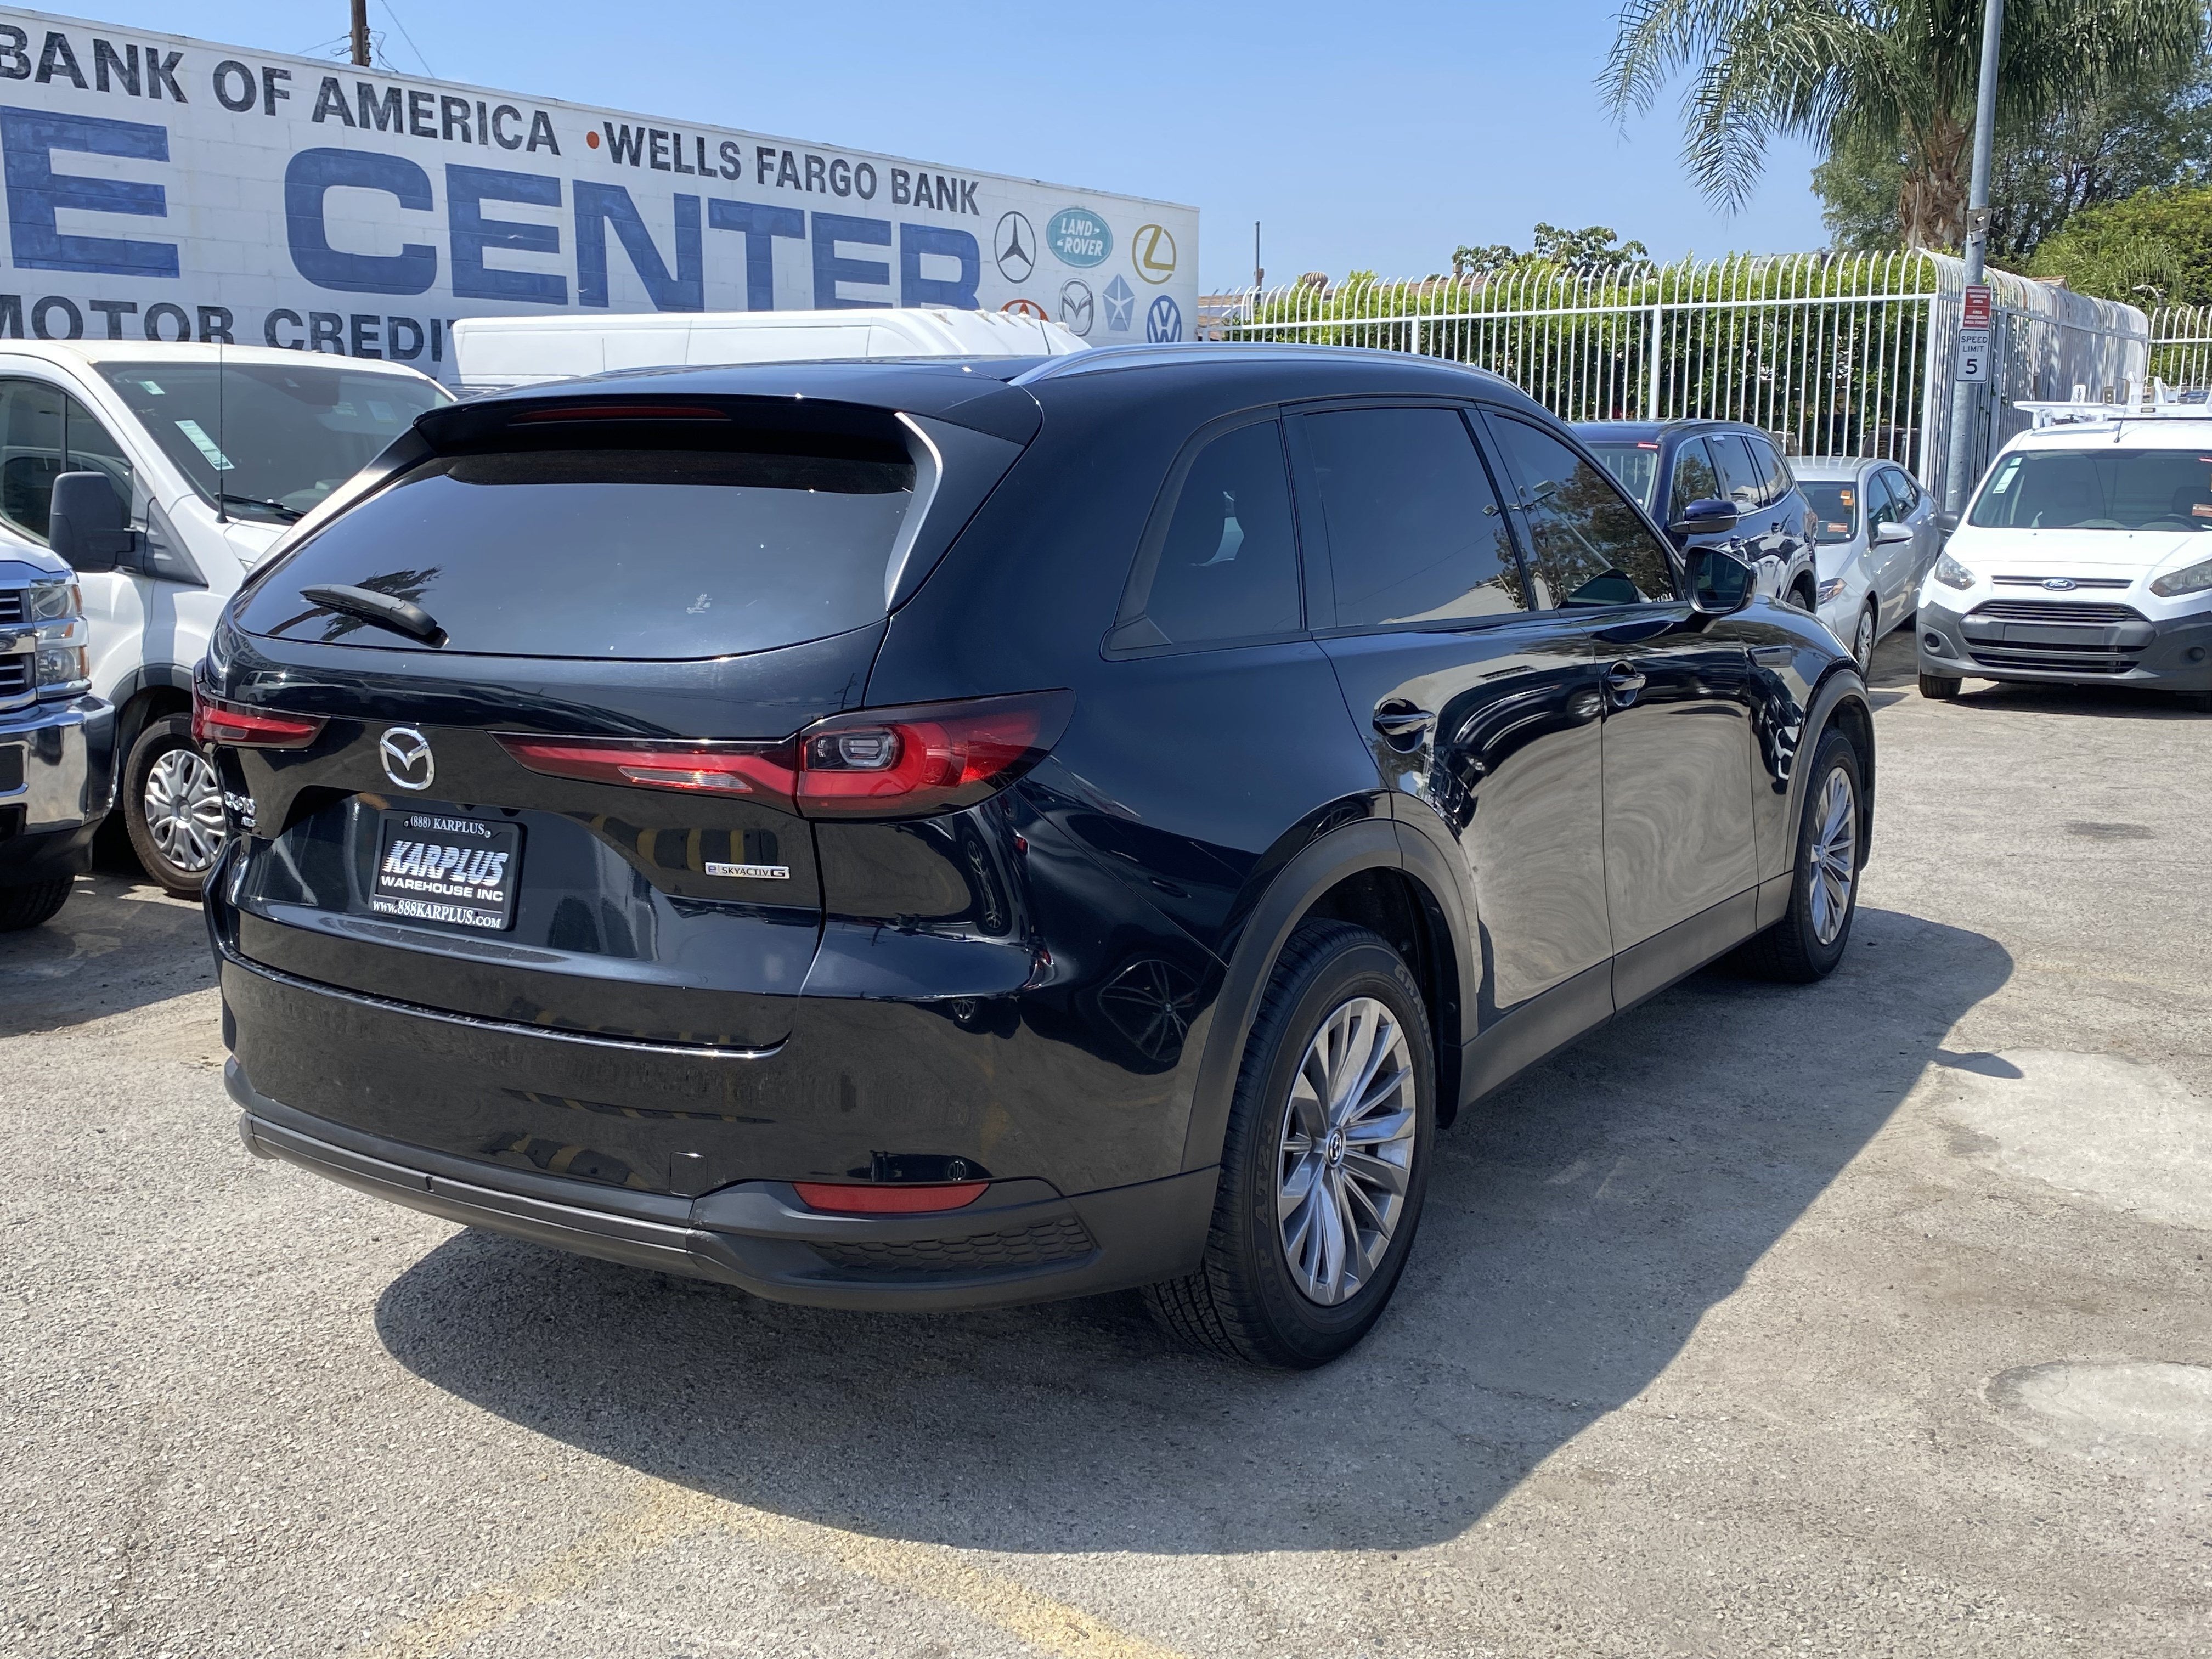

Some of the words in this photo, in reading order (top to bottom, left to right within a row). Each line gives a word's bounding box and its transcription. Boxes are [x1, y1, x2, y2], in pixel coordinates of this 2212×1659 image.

[0, 24, 188, 104] BANK
[213, 60, 291, 116] OF
[311, 77, 561, 156] AMERICA
[603, 121, 742, 180] WELLS
[756, 146, 877, 200] FARGO
[891, 168, 980, 216] BANK
[284, 146, 980, 312] CENTER
[1060, 218, 1092, 236] LAND
[1063, 238, 1103, 257] ROVER
[1966, 358, 1978, 375] 5
[410, 815, 431, 829] (888)
[433, 817, 485, 836] KARPLUS
[382, 839, 509, 887] KARPLUS
[381, 875, 473, 898] WAREHOUSE
[477, 888, 504, 901] INC
